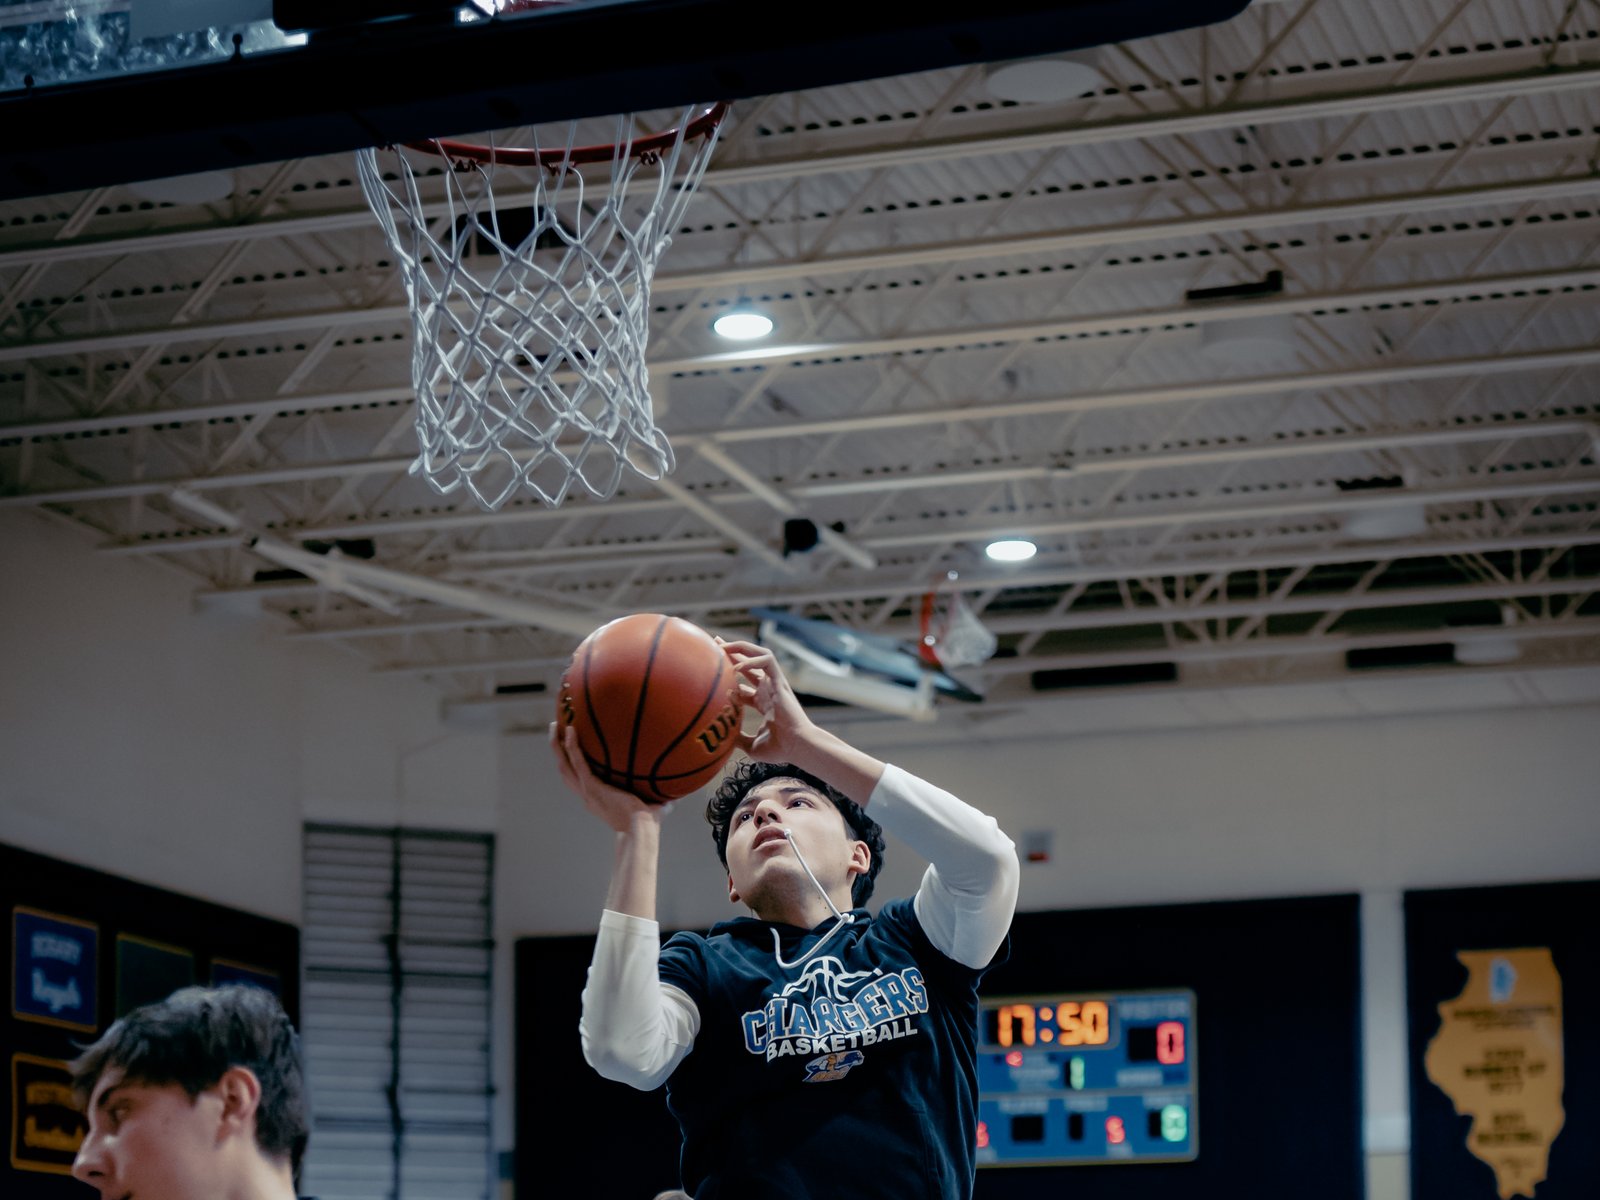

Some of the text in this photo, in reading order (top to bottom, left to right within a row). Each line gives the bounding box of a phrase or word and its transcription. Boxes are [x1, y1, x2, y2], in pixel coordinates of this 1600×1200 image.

[741, 967, 929, 1055] CHARGERS
[998, 1002, 1109, 1047] 17:50
[766, 1018, 918, 1062] BASKETBALL
[1156, 1021, 1185, 1064] 0
